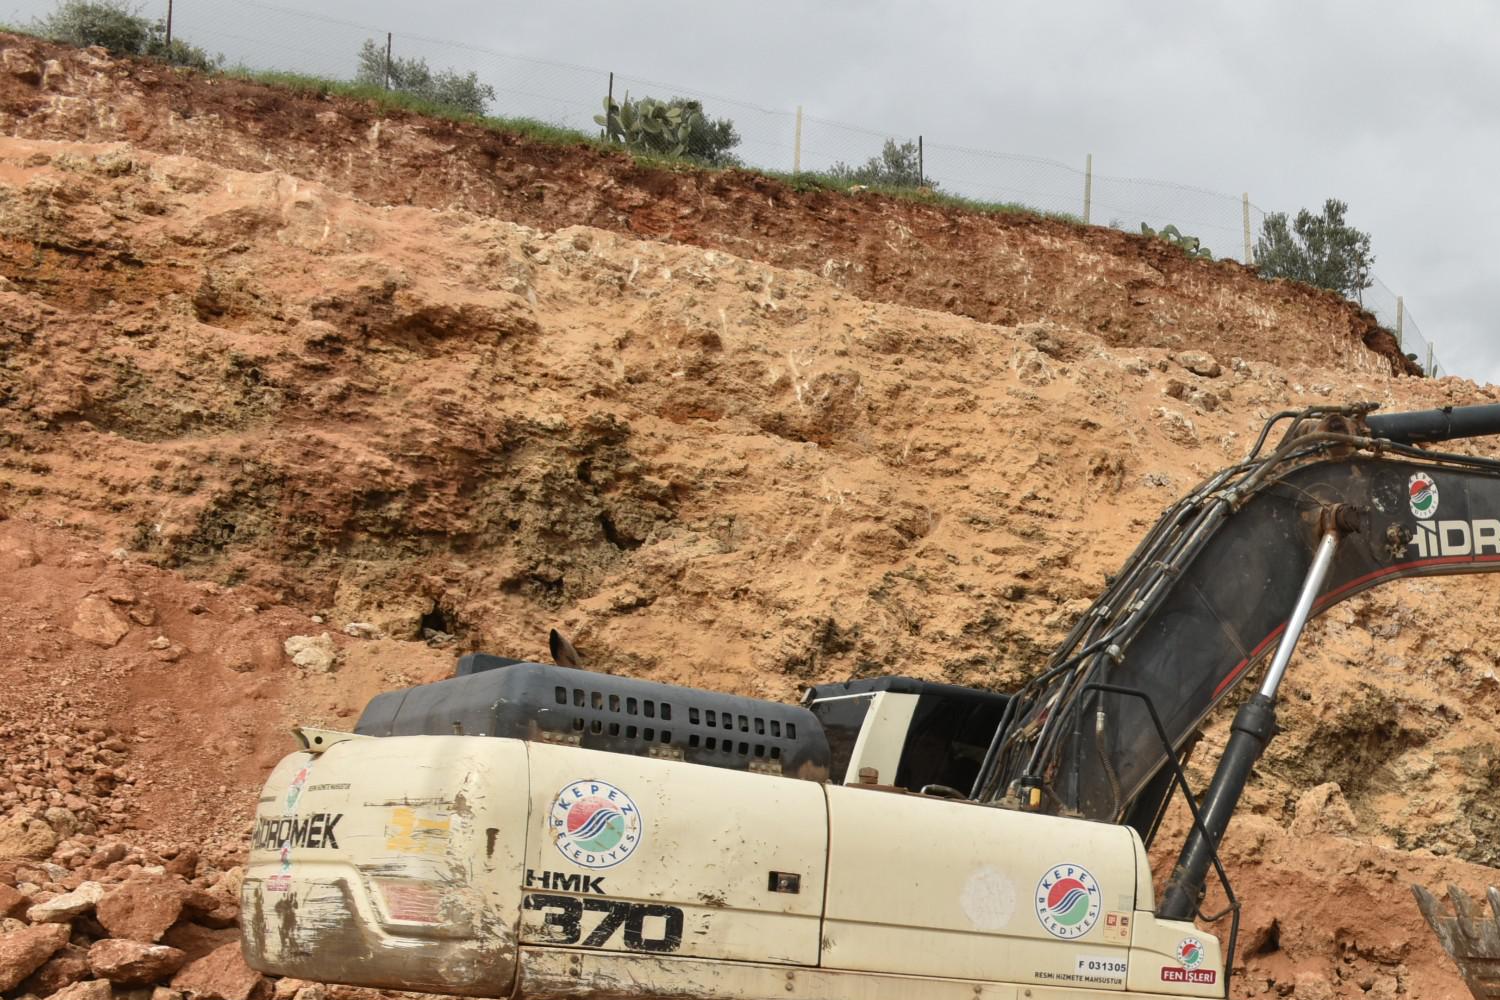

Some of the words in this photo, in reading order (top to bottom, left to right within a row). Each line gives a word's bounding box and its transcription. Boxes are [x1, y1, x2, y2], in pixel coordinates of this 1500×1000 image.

[558, 784, 634, 816] KEPEZ
[525, 868, 607, 895] HMK
[1042, 867, 1097, 895] KEPEZ
[523, 893, 685, 953] 370
[1078, 960, 1085, 969] F
[1088, 961, 1127, 973] 031305
[1163, 970, 1183, 980] FEN
